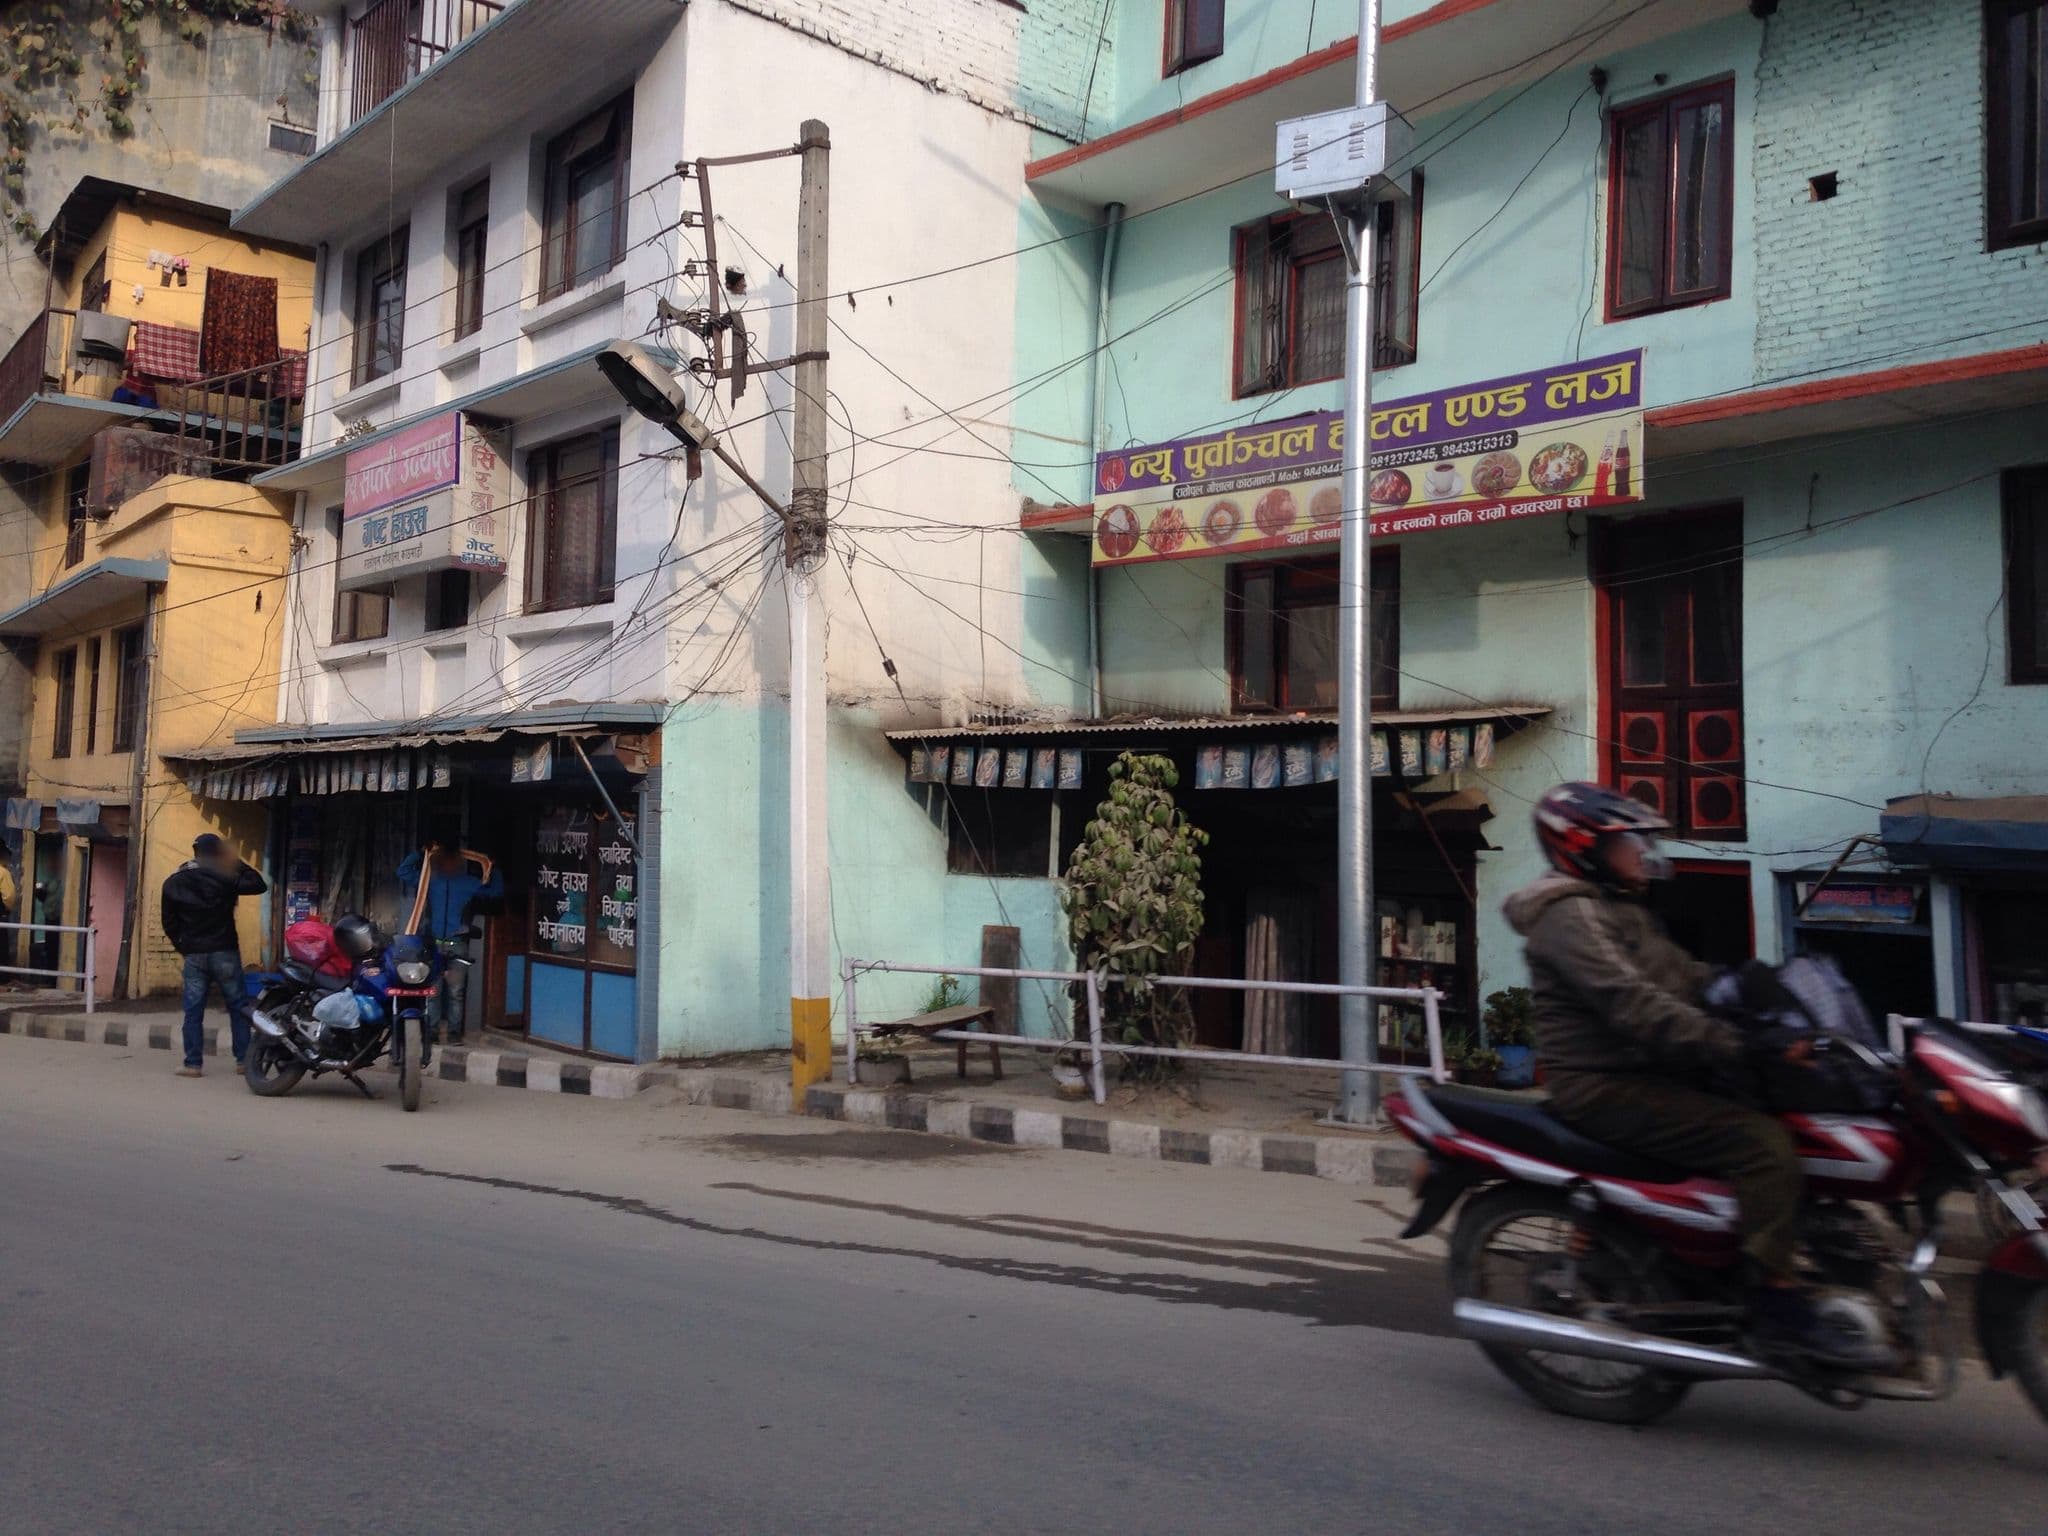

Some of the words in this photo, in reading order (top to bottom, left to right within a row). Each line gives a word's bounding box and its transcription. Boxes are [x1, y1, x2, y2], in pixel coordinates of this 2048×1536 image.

[1444, 382, 1533, 427] एण्ड
[1544, 360, 1637, 410] लज
[1278, 468, 1301, 484] Mob:
[1442, 434, 1513, 458] 9843315313
[1380, 521, 1389, 534] र
[1440, 510, 1473, 526] लागि
[1476, 503, 1506, 521] राम्रो
[562, 871, 589, 894] हाउस
[615, 874, 634, 892] तथा
[538, 915, 587, 945] भोजनालय
